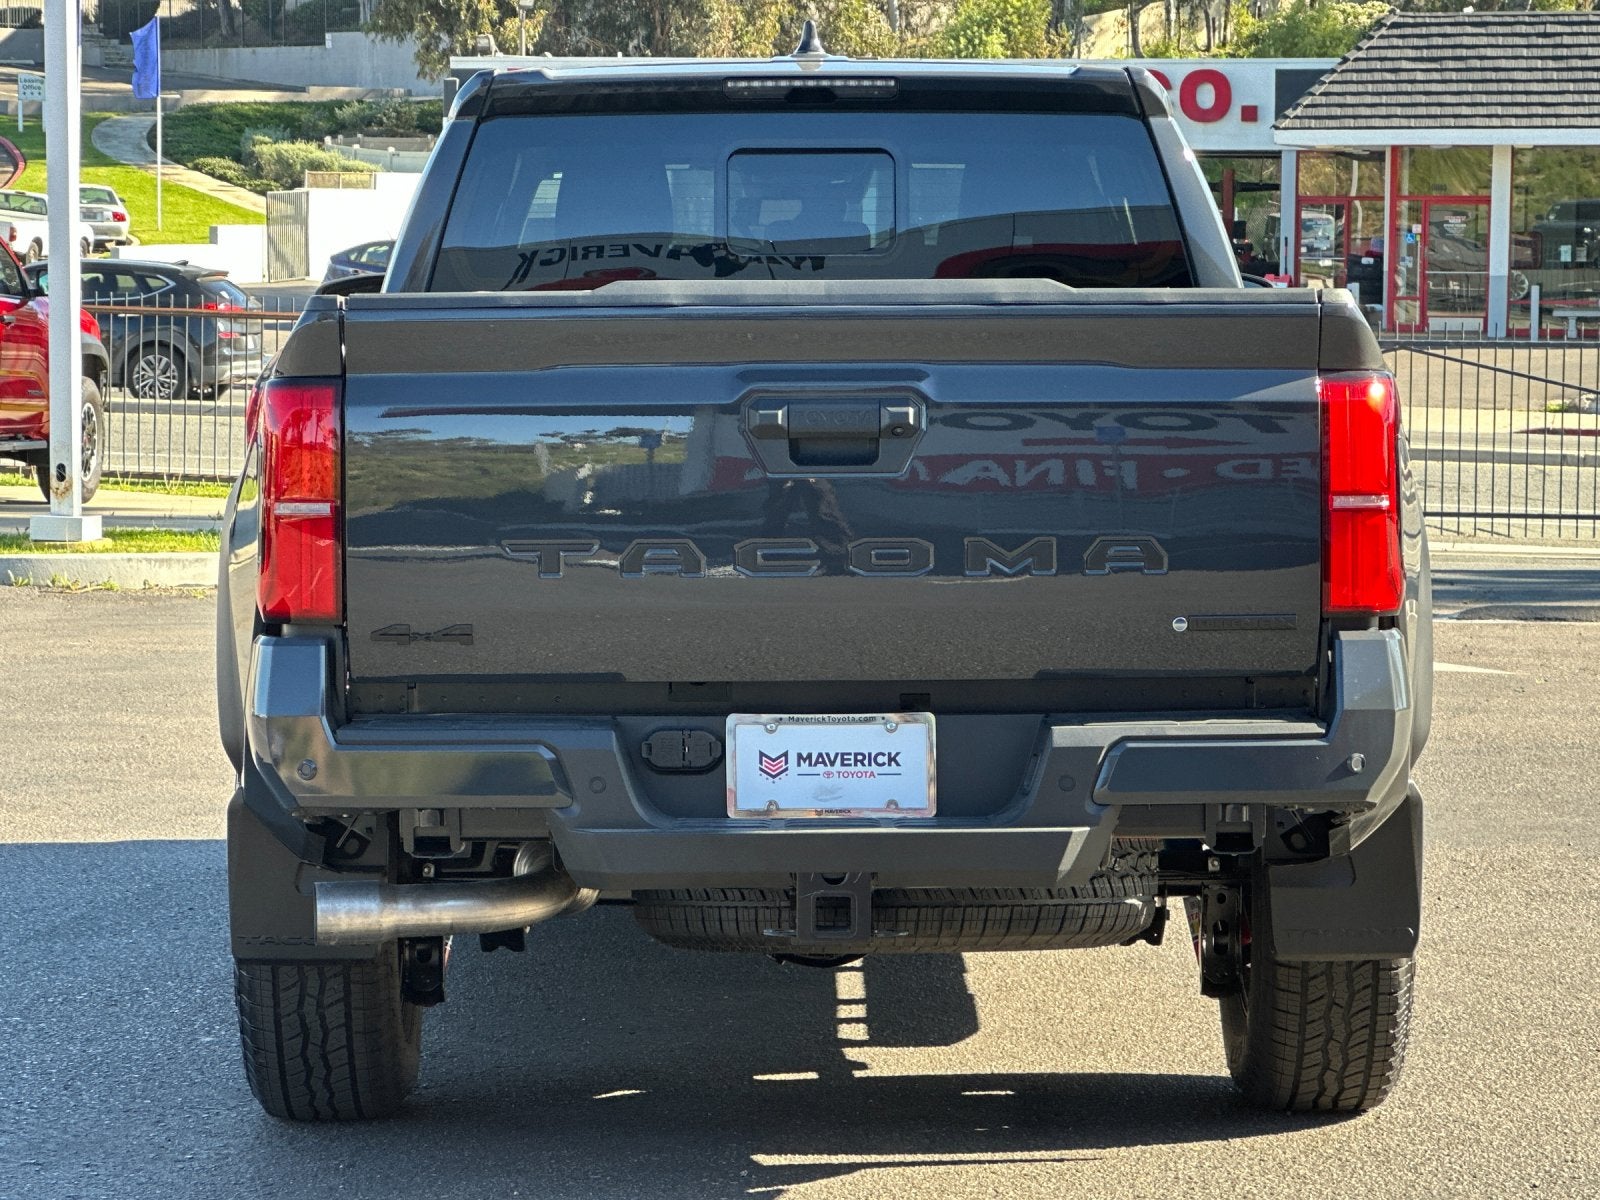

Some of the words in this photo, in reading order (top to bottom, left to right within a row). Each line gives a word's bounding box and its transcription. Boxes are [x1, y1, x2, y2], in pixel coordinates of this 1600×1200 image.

[1147, 69, 1258, 122] O.
[500, 536, 1169, 578] TACOMA
[788, 715, 877, 724] MaverickToyota.com
[796, 751, 902, 768] MAVERICK
[836, 770, 877, 779] TOYOTA
